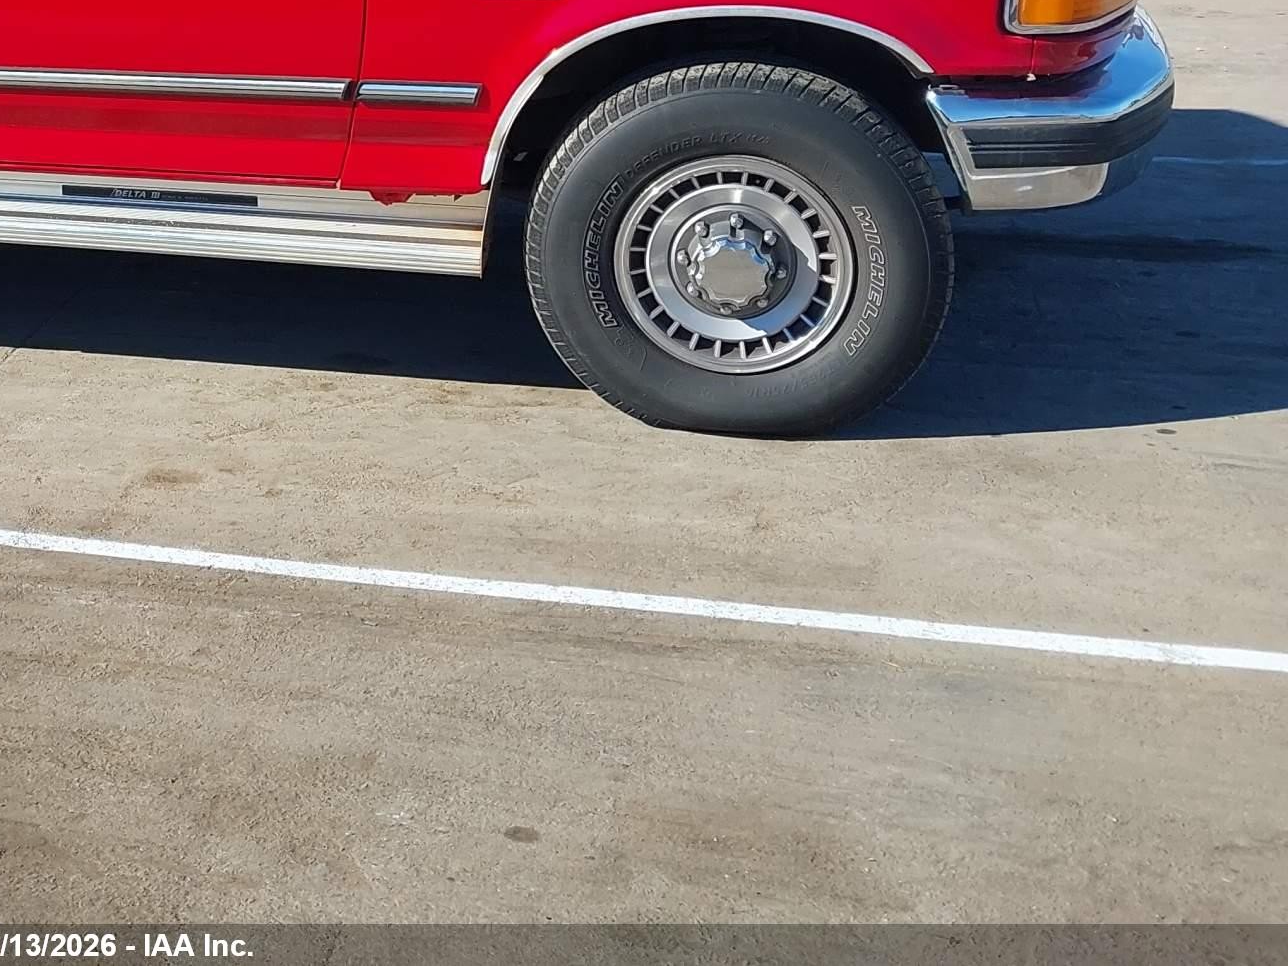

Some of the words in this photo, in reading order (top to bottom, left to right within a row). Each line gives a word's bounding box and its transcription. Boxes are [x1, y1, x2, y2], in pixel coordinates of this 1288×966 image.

[113, 188, 147, 199] DELTA
[584, 181, 623, 327] MICHELIN
[843, 205, 885, 356] MICHELIN
